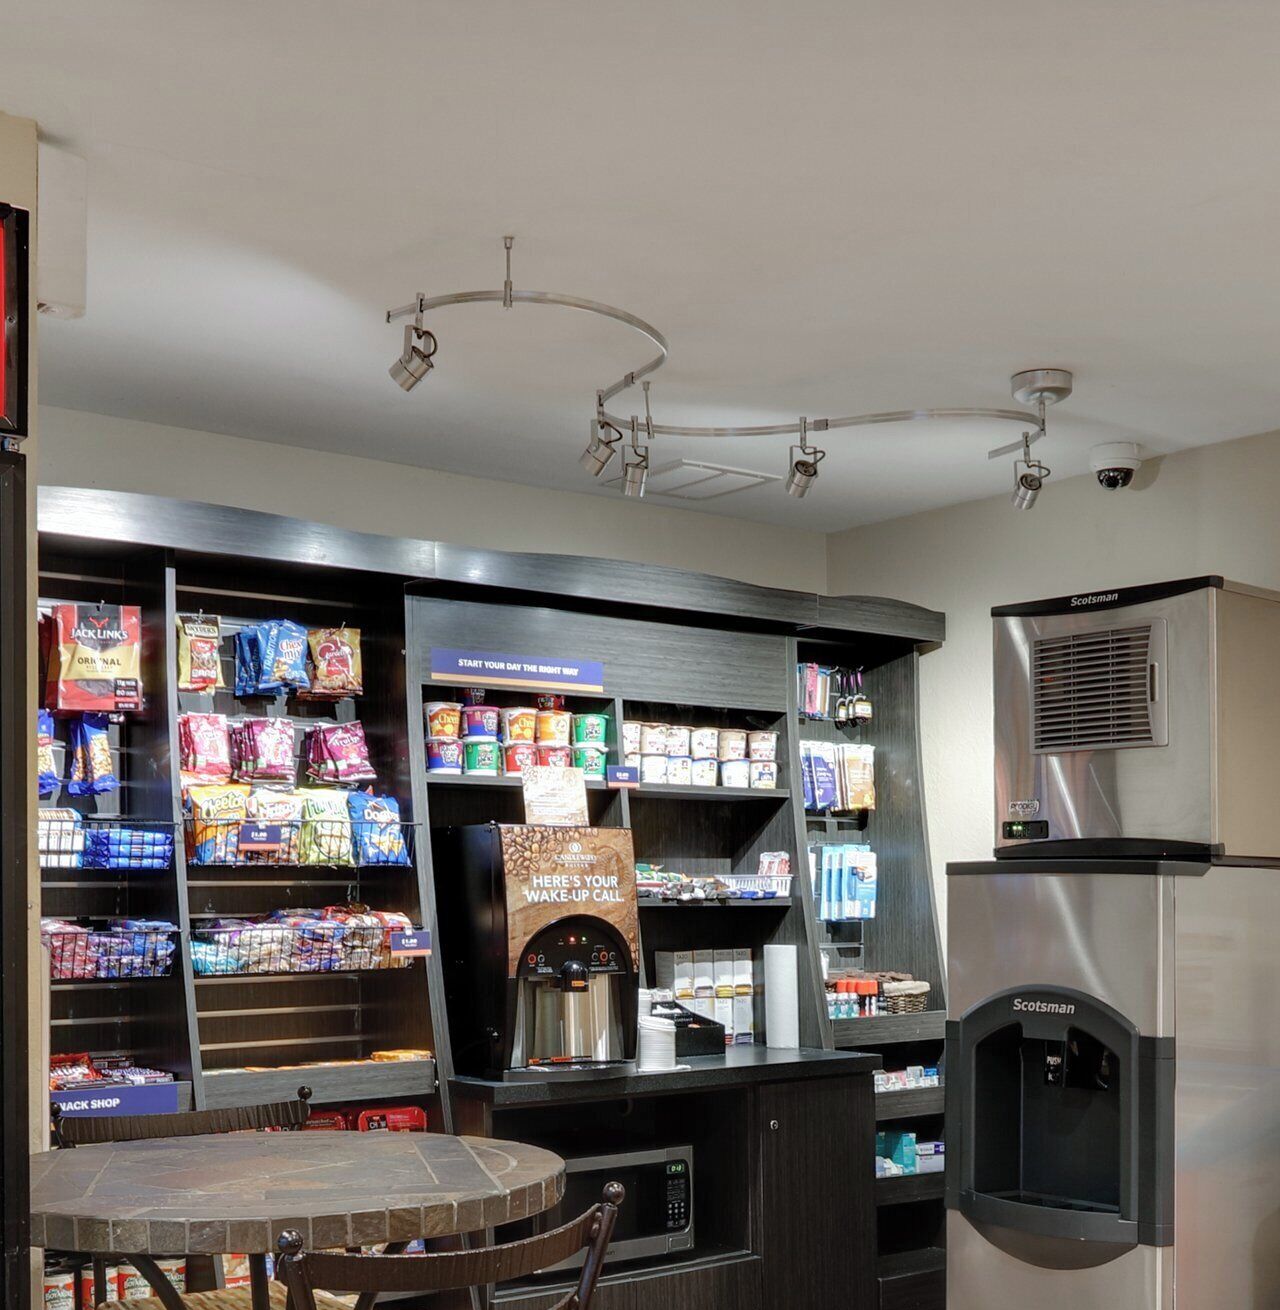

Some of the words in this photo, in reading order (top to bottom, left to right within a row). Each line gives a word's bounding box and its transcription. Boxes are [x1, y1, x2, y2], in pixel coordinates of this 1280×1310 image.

[1070, 591, 1119, 607] Scotsman
[70, 627, 97, 640] JACK
[279, 638, 302, 652] Chex
[77, 656, 122, 667] ORINAL
[458, 658, 482, 669] START
[483, 660, 506, 671] YOUR
[506, 662, 522, 672] DAY
[522, 664, 538, 673] THE
[538, 665, 561, 675] RIGHT
[562, 667, 579, 677] WAY
[202, 790, 247, 820] Cheetos
[532, 875, 581, 888] HERE'S
[583, 875, 619, 888] YOUR
[524, 889, 590, 903] WAKE-UP
[593, 889, 625, 902] CALL.
[1013, 998, 1076, 1015] Scotsman
[59, 1100, 89, 1111] NACK
[90, 1098, 121, 1109] SHOP
